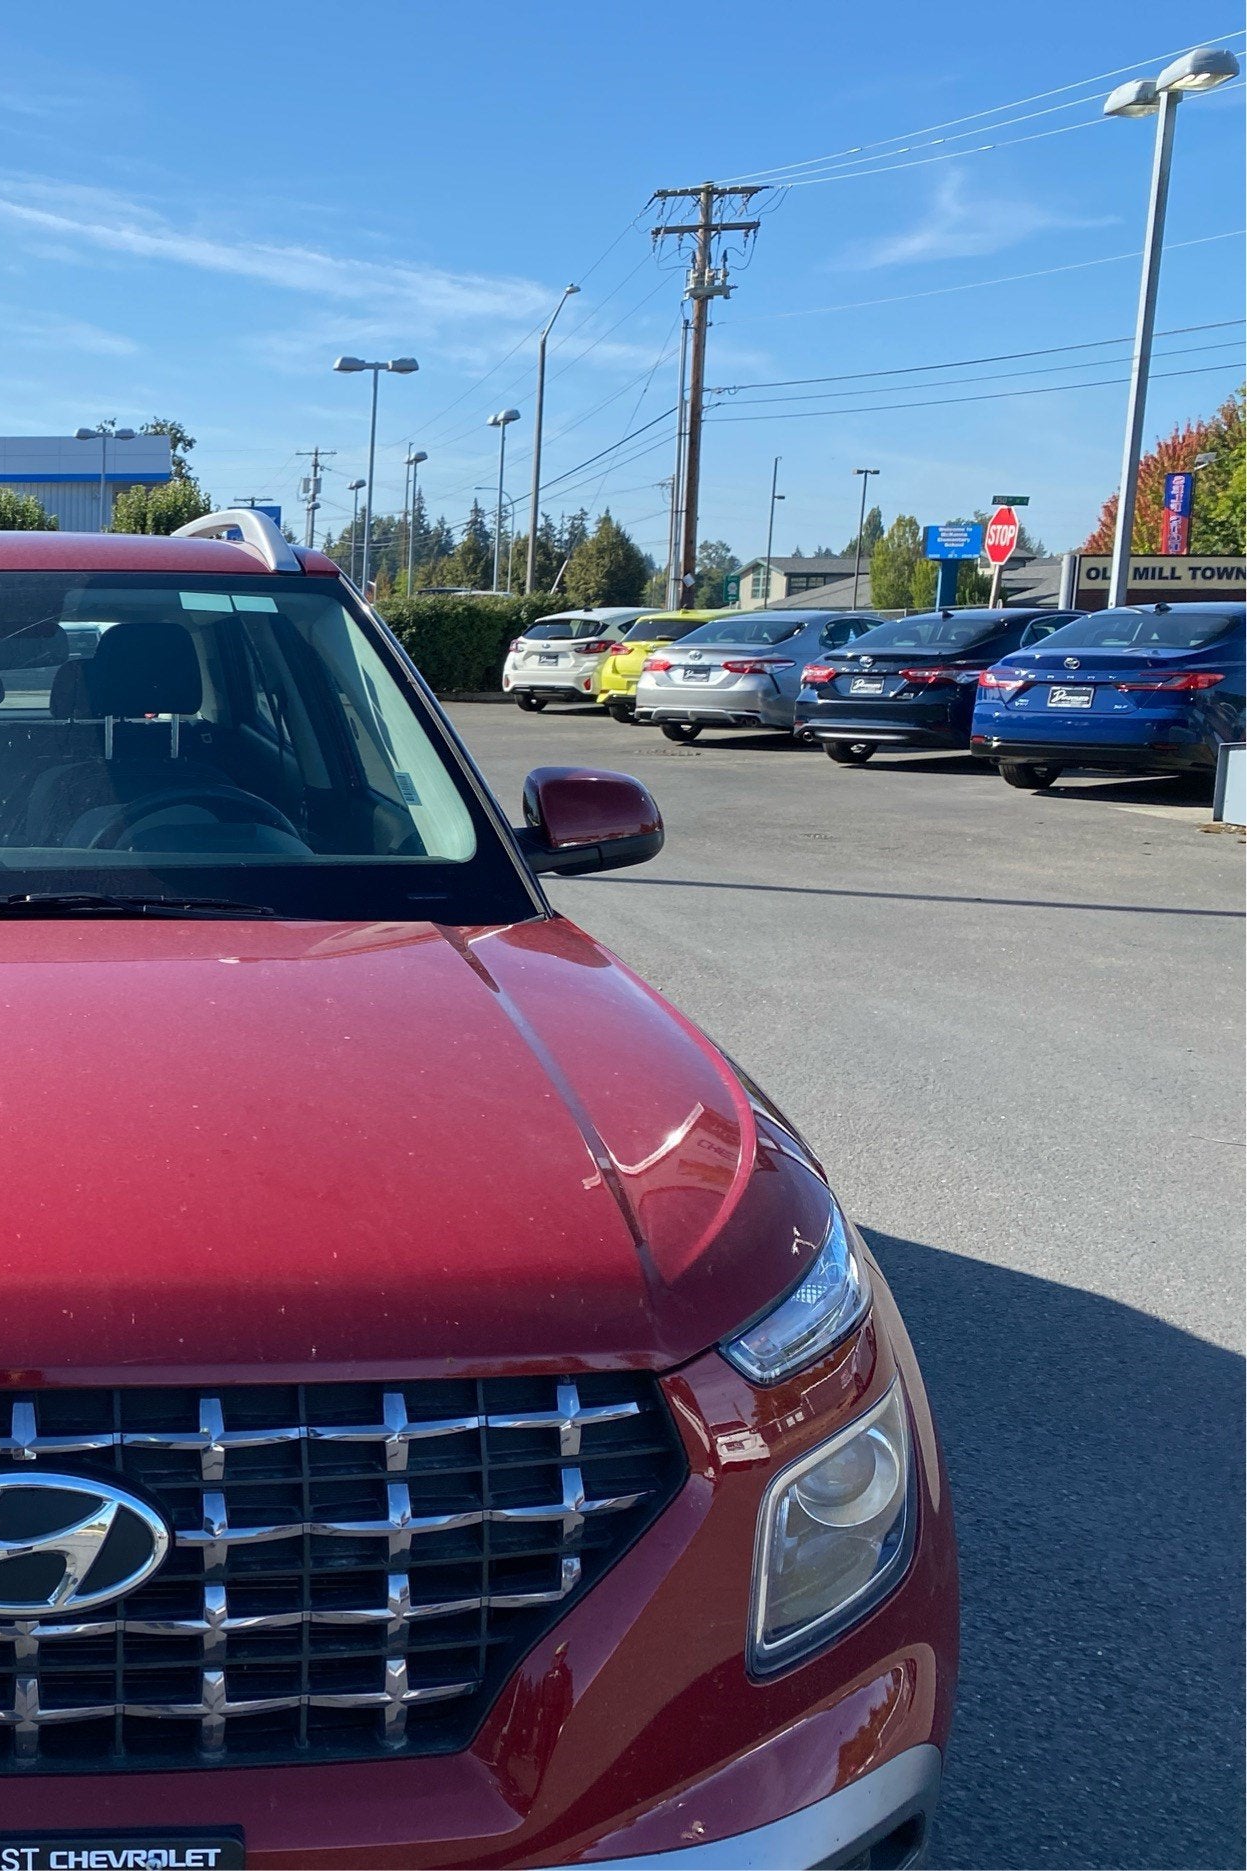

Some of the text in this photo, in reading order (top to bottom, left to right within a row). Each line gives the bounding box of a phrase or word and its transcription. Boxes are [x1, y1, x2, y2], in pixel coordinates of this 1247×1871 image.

[988, 525, 1016, 546] STOP
[1085, 566, 1246, 581] OL MILL TOWN
[49, 1848, 221, 1870] CHEVROLET
